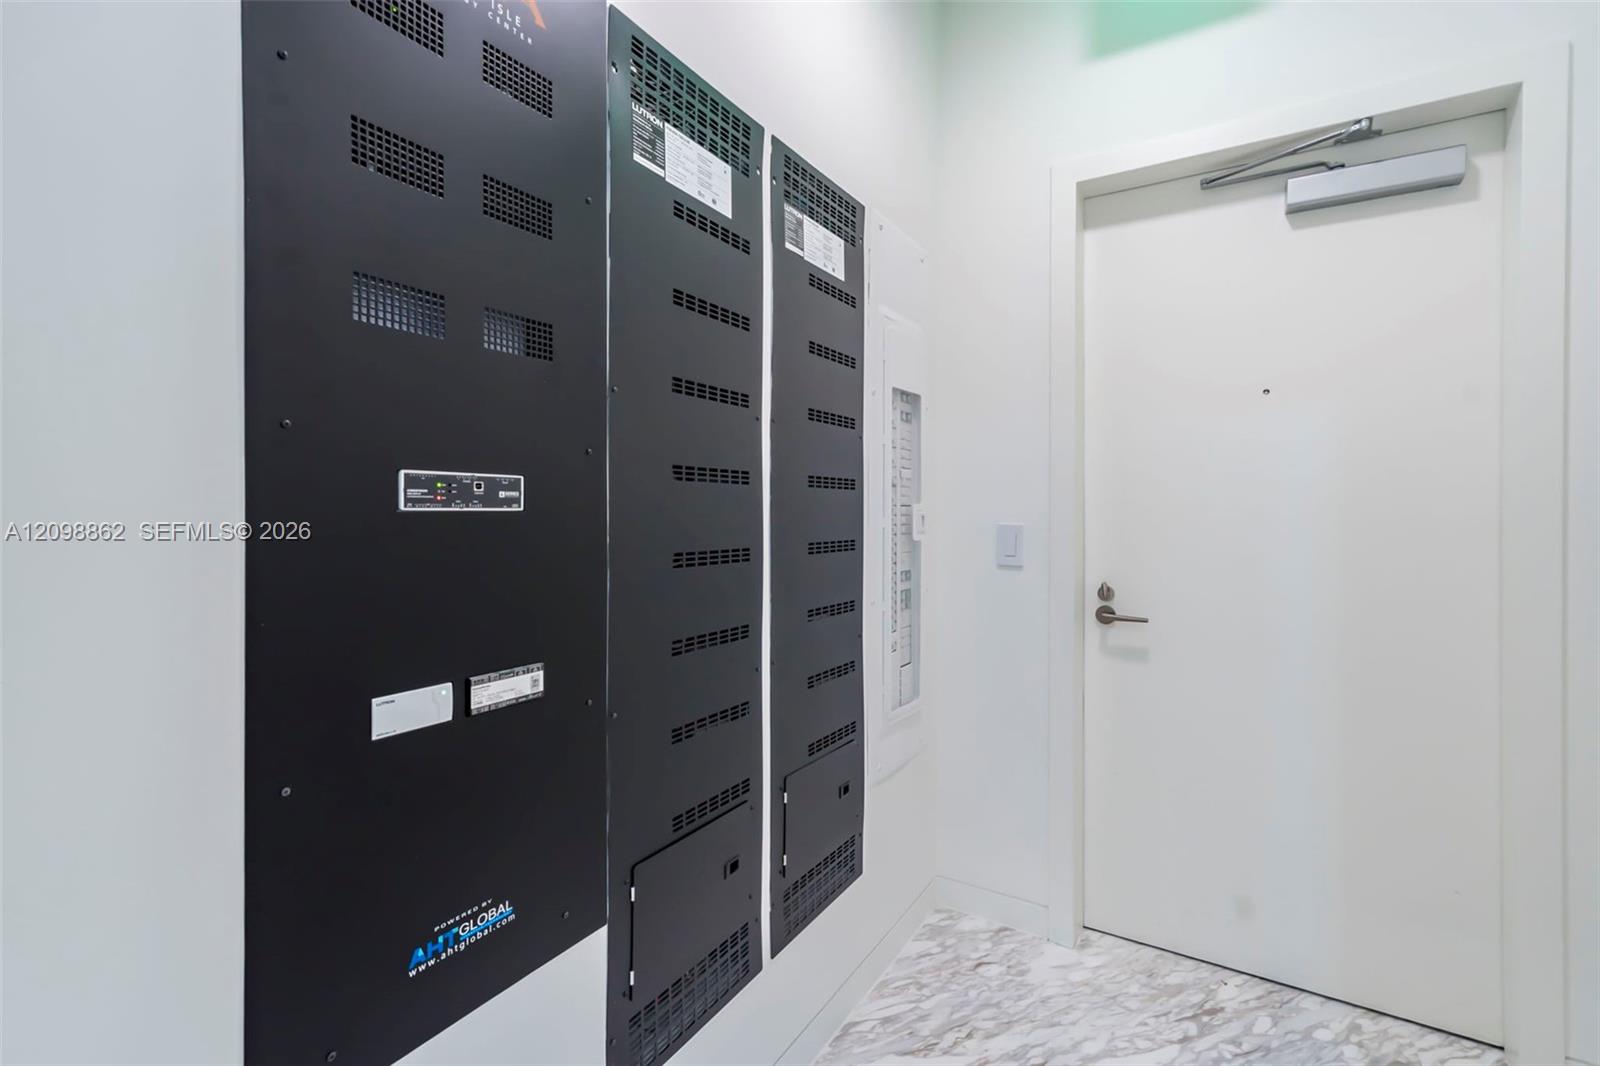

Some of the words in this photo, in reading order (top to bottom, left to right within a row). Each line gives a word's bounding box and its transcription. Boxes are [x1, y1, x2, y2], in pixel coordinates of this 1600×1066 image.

[488, 11, 532, 44] CENTER
[491, 0, 521, 27] ISLE
[631, 101, 664, 128] LUTRON
[434, 906, 479, 932] POWERED
[481, 898, 493, 907] BY
[408, 914, 516, 978] www.ahtglobal.com
